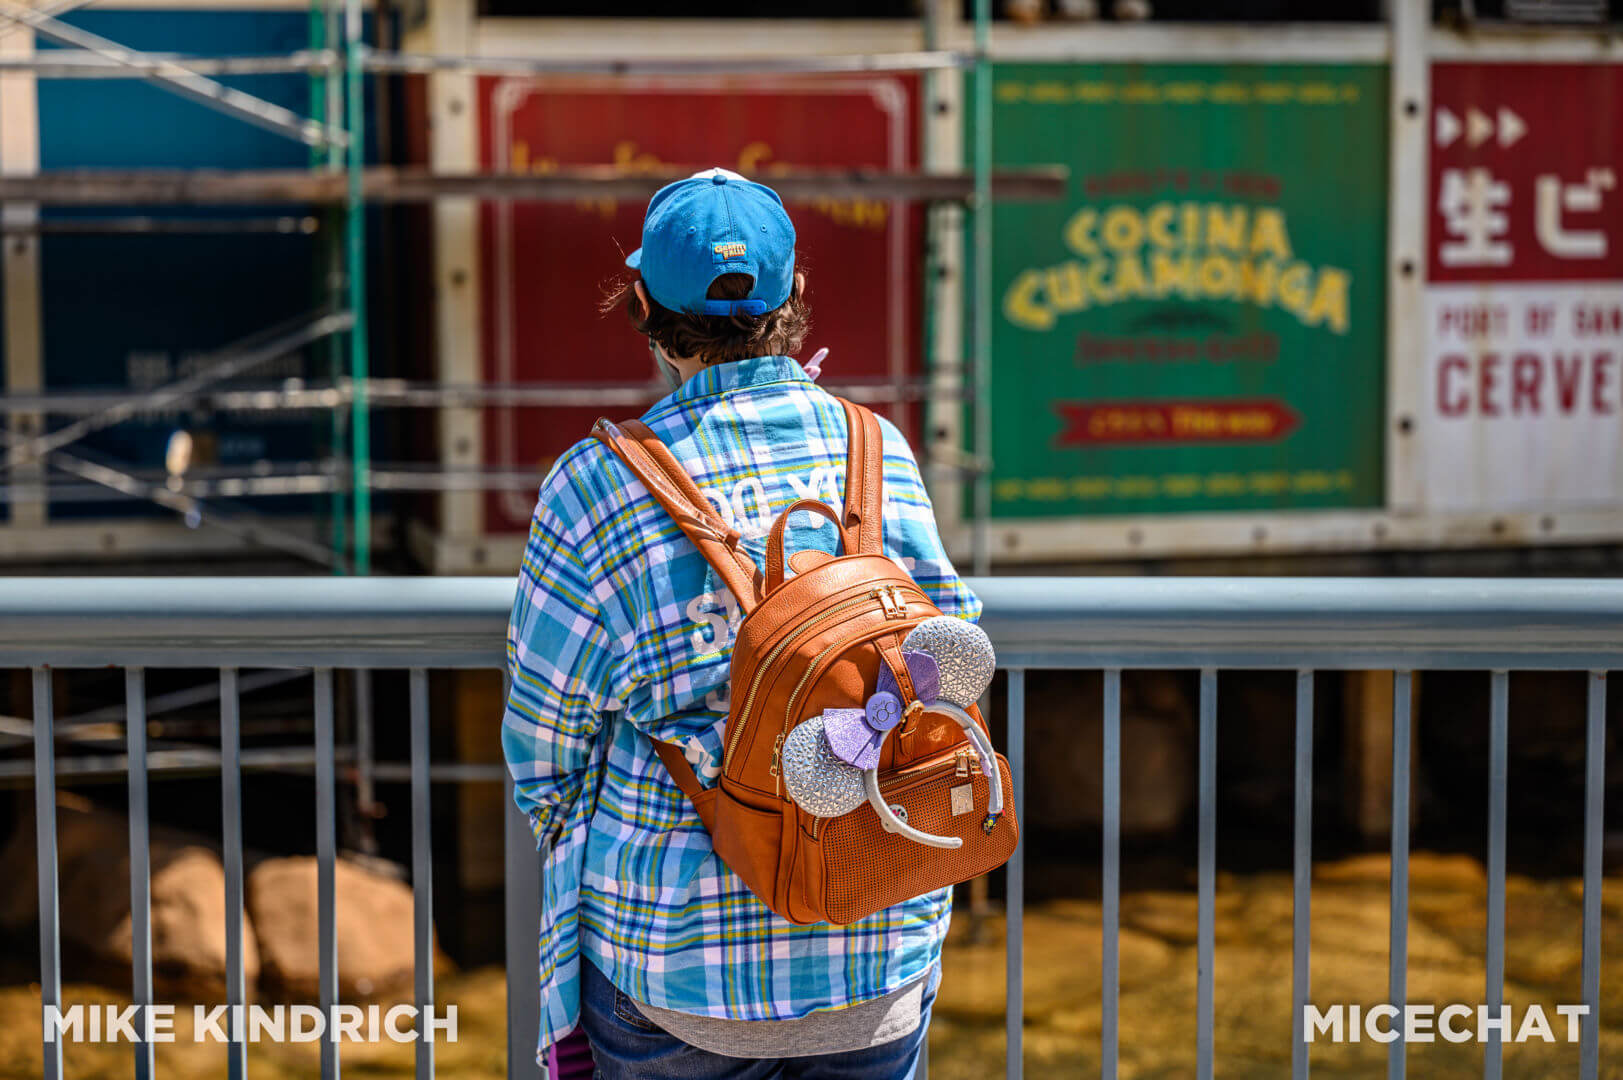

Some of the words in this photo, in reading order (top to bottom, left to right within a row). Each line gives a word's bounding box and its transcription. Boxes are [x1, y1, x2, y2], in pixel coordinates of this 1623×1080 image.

[1065, 203, 1292, 262] COCINA
[1004, 252, 1351, 334] CUCAMONGA
[1437, 304, 1508, 340] PORT
[1526, 304, 1556, 338] OF
[1436, 352, 1623, 418] CERVE
